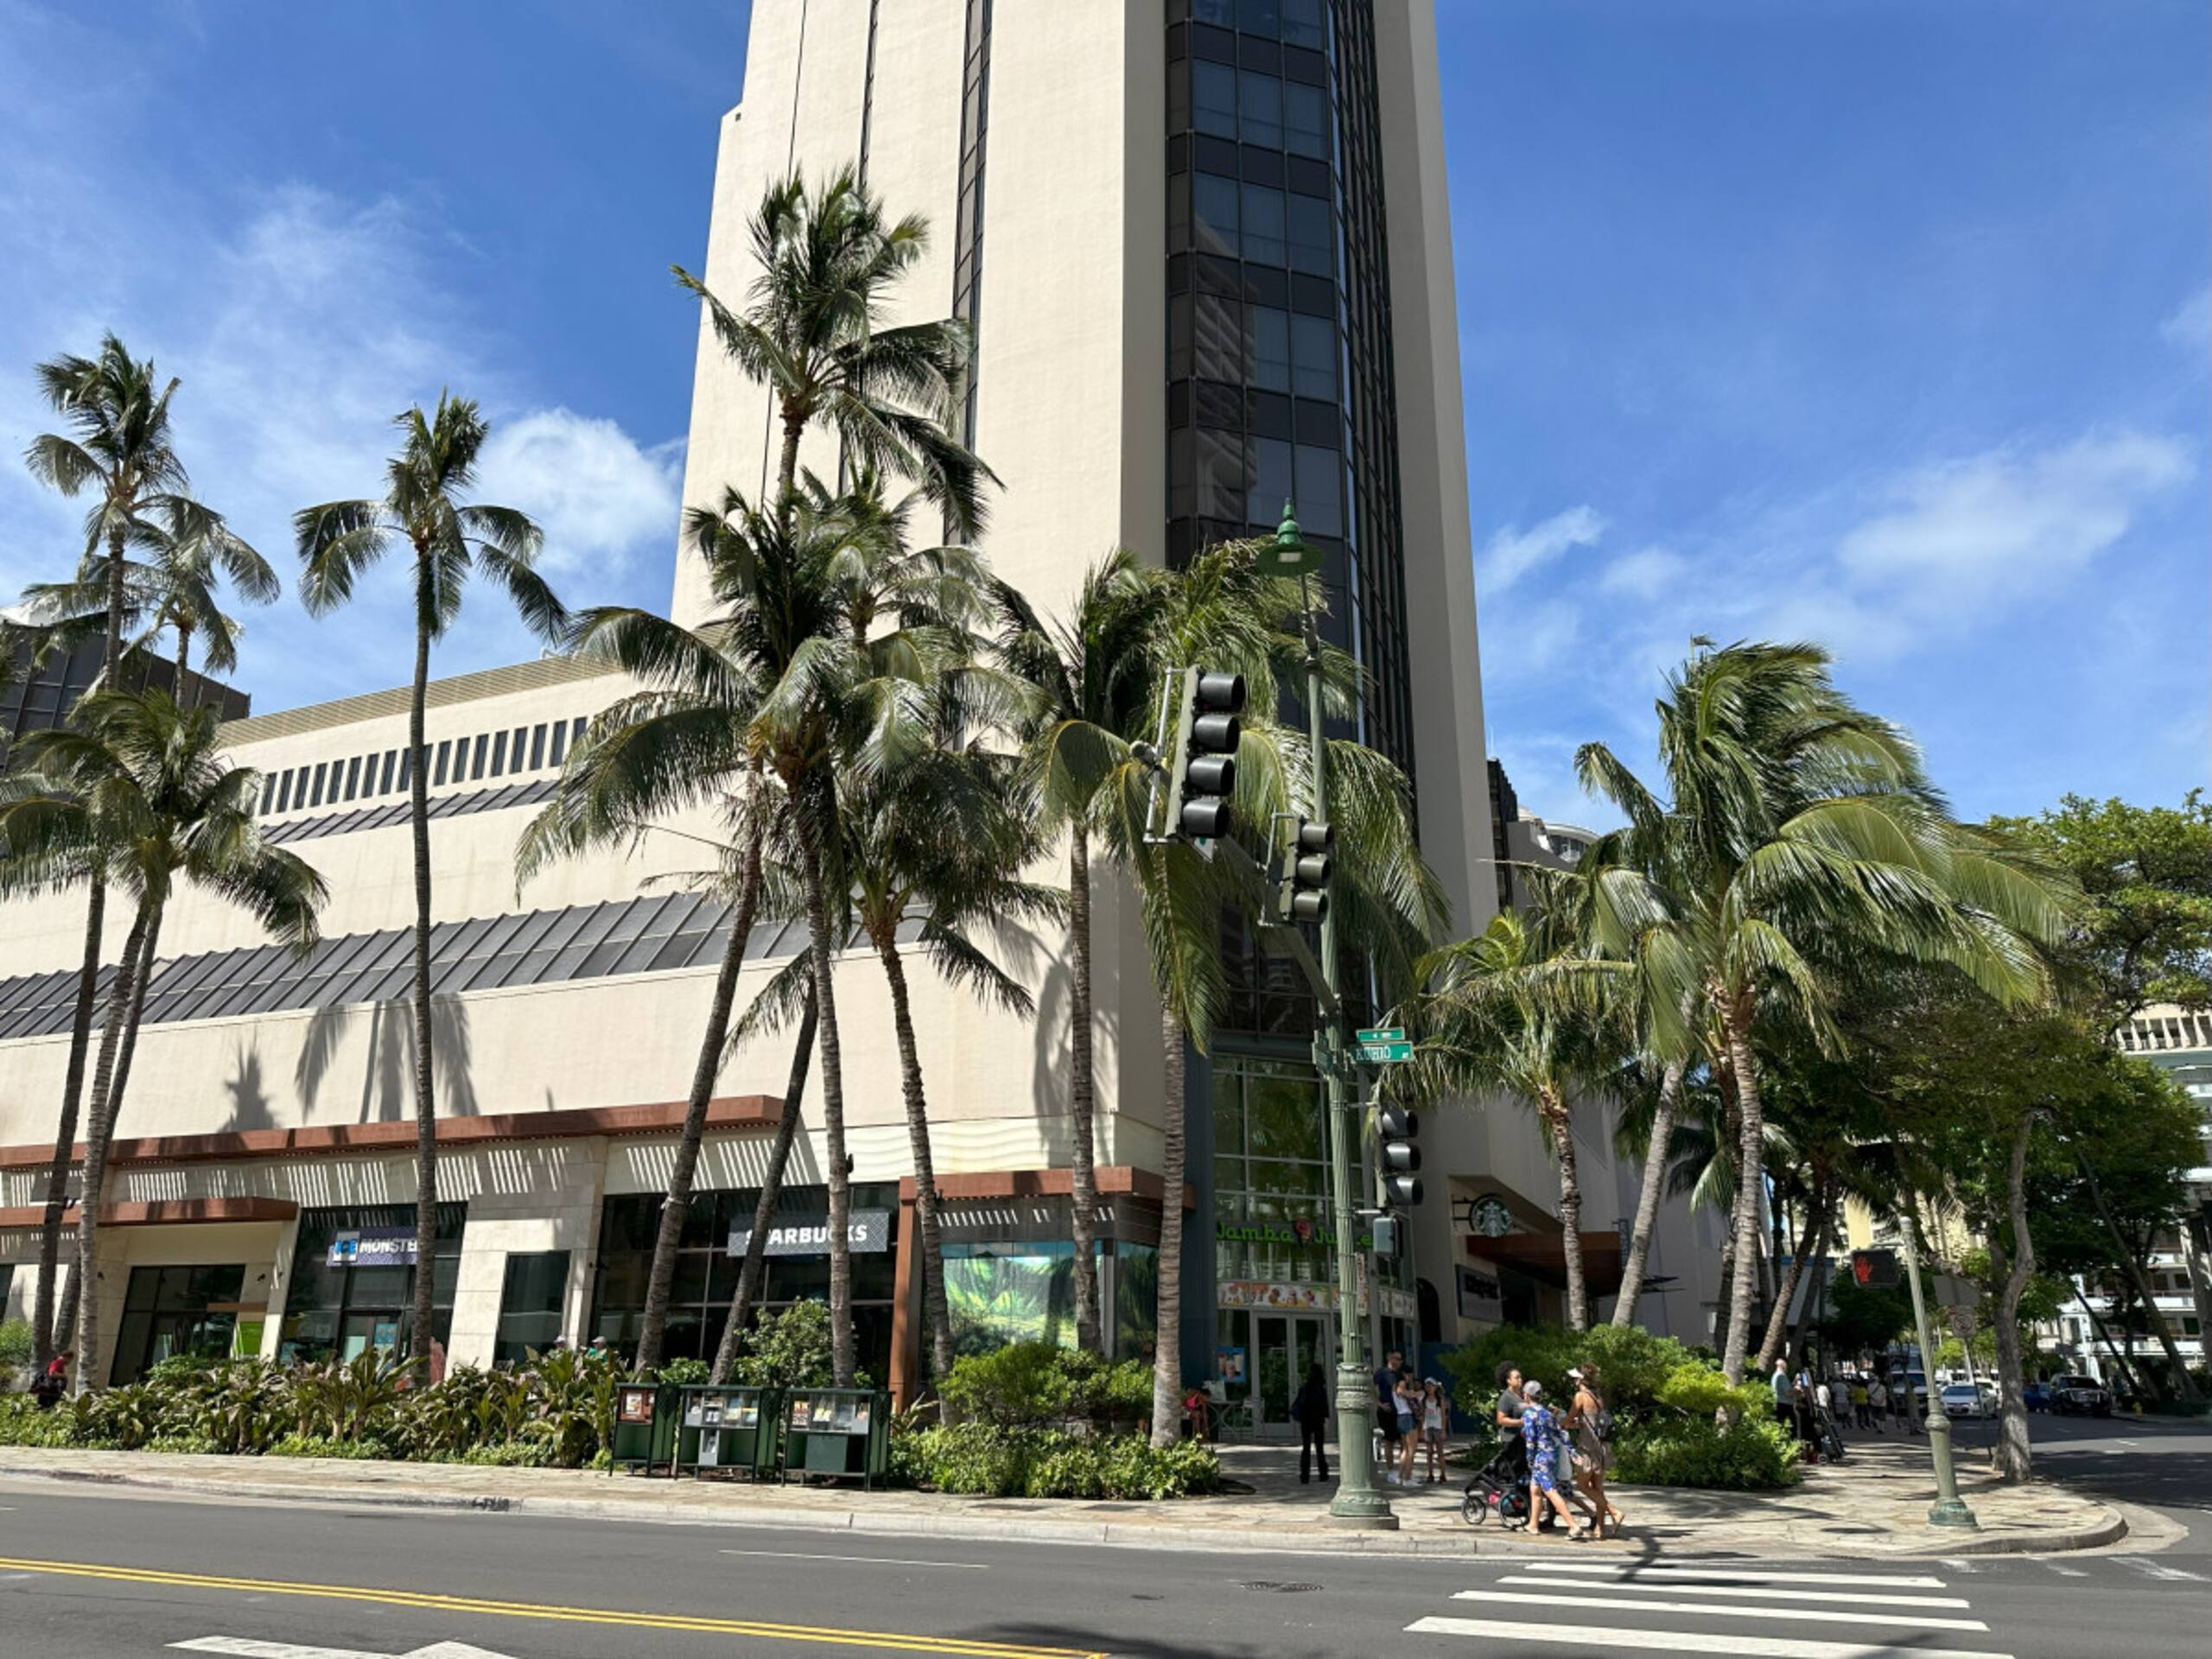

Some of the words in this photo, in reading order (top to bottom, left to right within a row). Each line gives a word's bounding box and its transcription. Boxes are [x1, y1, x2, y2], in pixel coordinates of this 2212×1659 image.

[1217, 1221, 1293, 1242] Jamba
[1314, 1225, 1372, 1245] Jue
[359, 1237, 417, 1254] MONSTE
